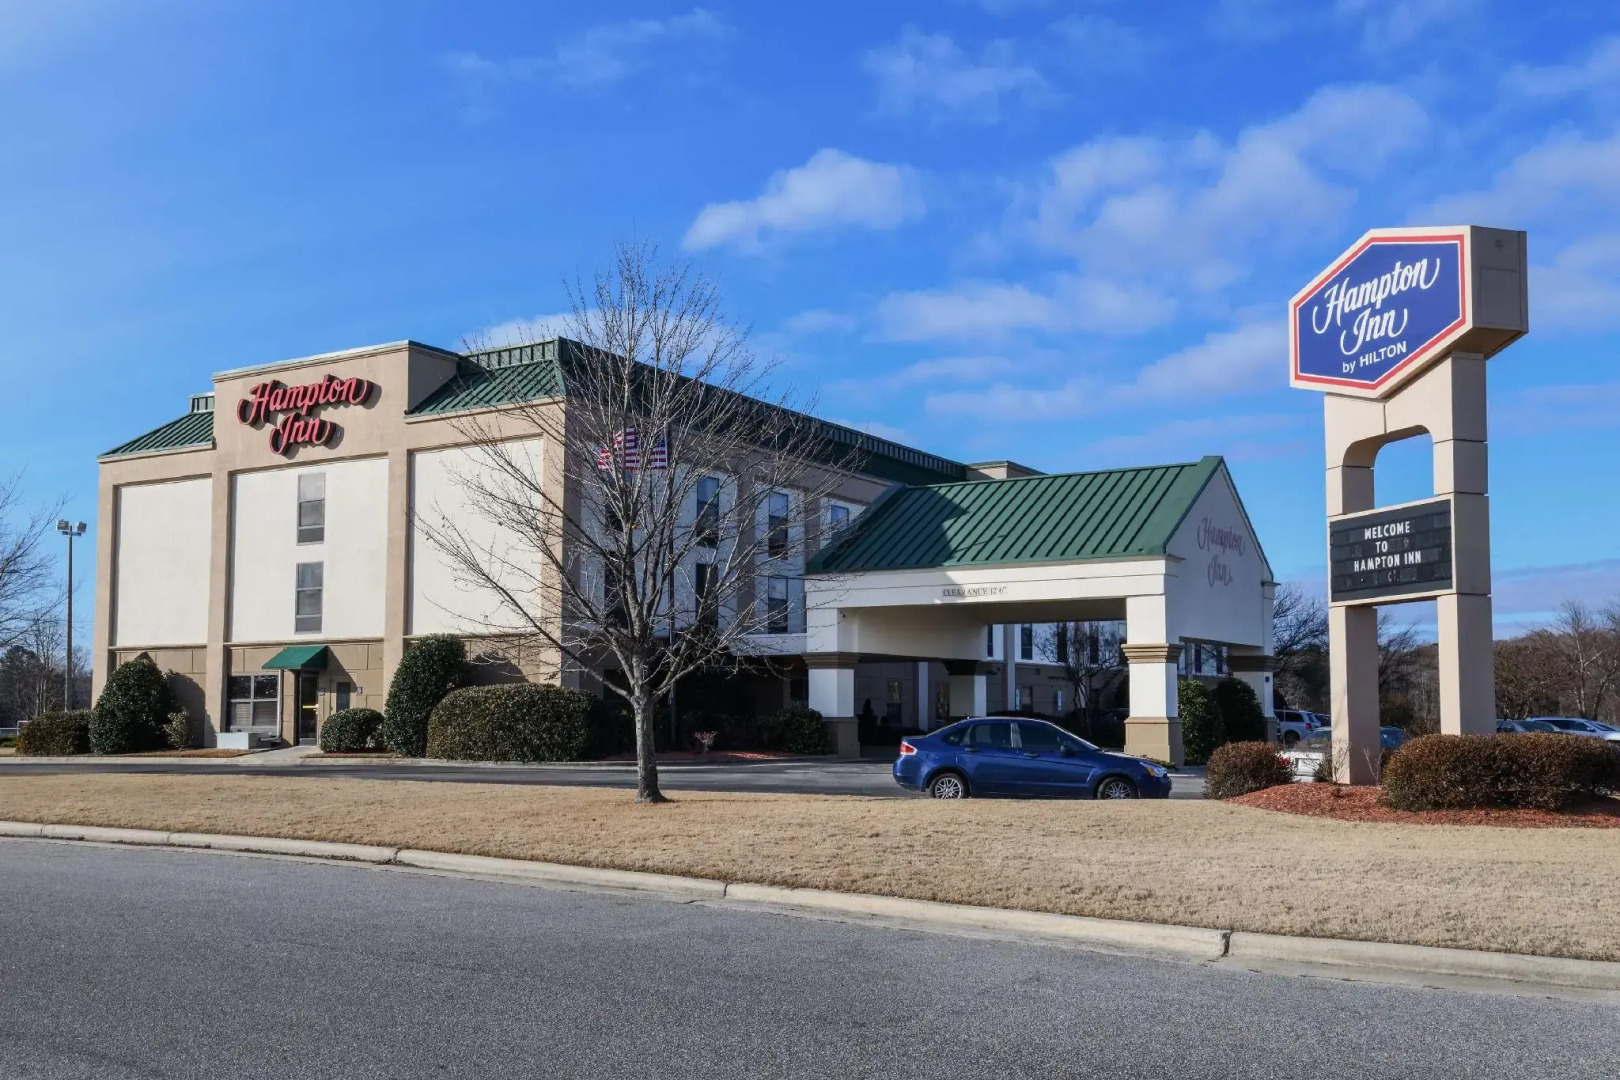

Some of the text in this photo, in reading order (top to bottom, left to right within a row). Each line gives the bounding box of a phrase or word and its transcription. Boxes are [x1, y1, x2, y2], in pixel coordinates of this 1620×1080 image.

[1313, 258, 1440, 335] Hampton
[1340, 308, 1408, 355] Inn
[1343, 341, 1407, 374] by HILTON
[237, 375, 371, 425] Hampton
[269, 413, 333, 454] Inn
[1197, 516, 1246, 556] Hampton
[1364, 521, 1411, 540] WELCOME
[1354, 551, 1422, 573] HAMPTON INN
[1375, 541, 1389, 554] TO
[1207, 554, 1231, 587] Inn
[942, 587, 987, 598] CLEARANCE
